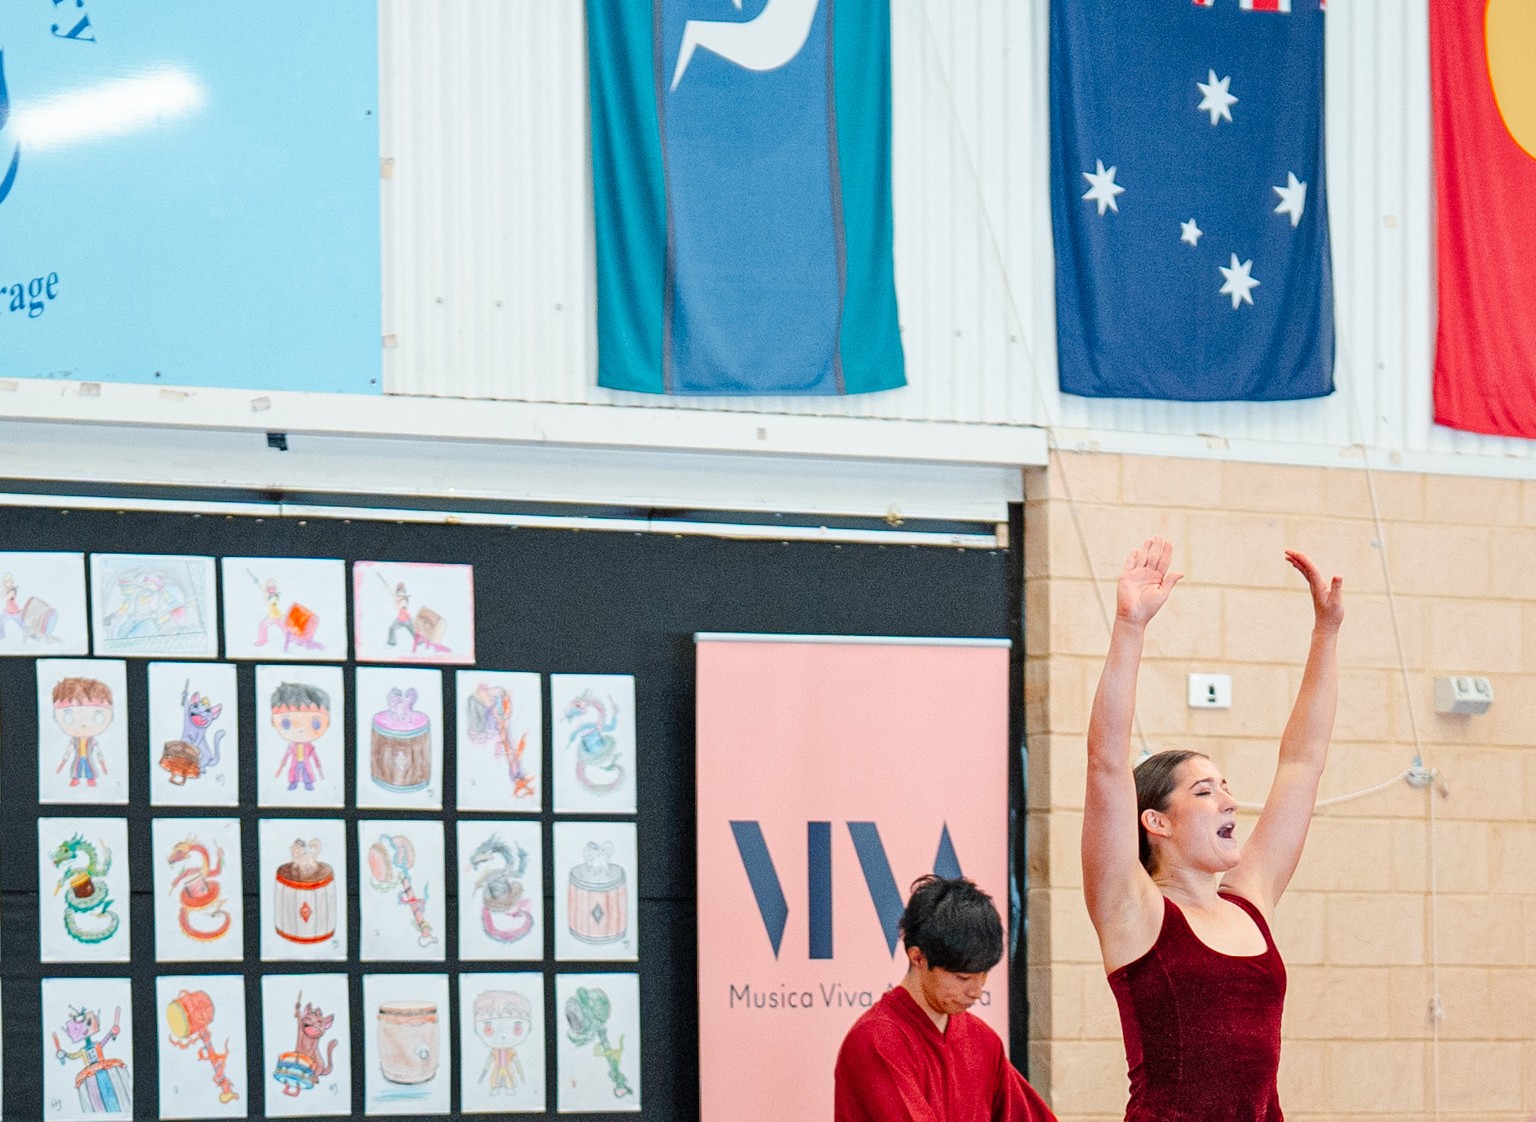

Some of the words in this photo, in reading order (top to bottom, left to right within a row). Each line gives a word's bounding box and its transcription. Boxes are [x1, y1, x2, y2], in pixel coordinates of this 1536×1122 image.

[50, 0, 97, 44] y
[729, 983, 813, 1008] Musica
[819, 983, 873, 1008] Viva
